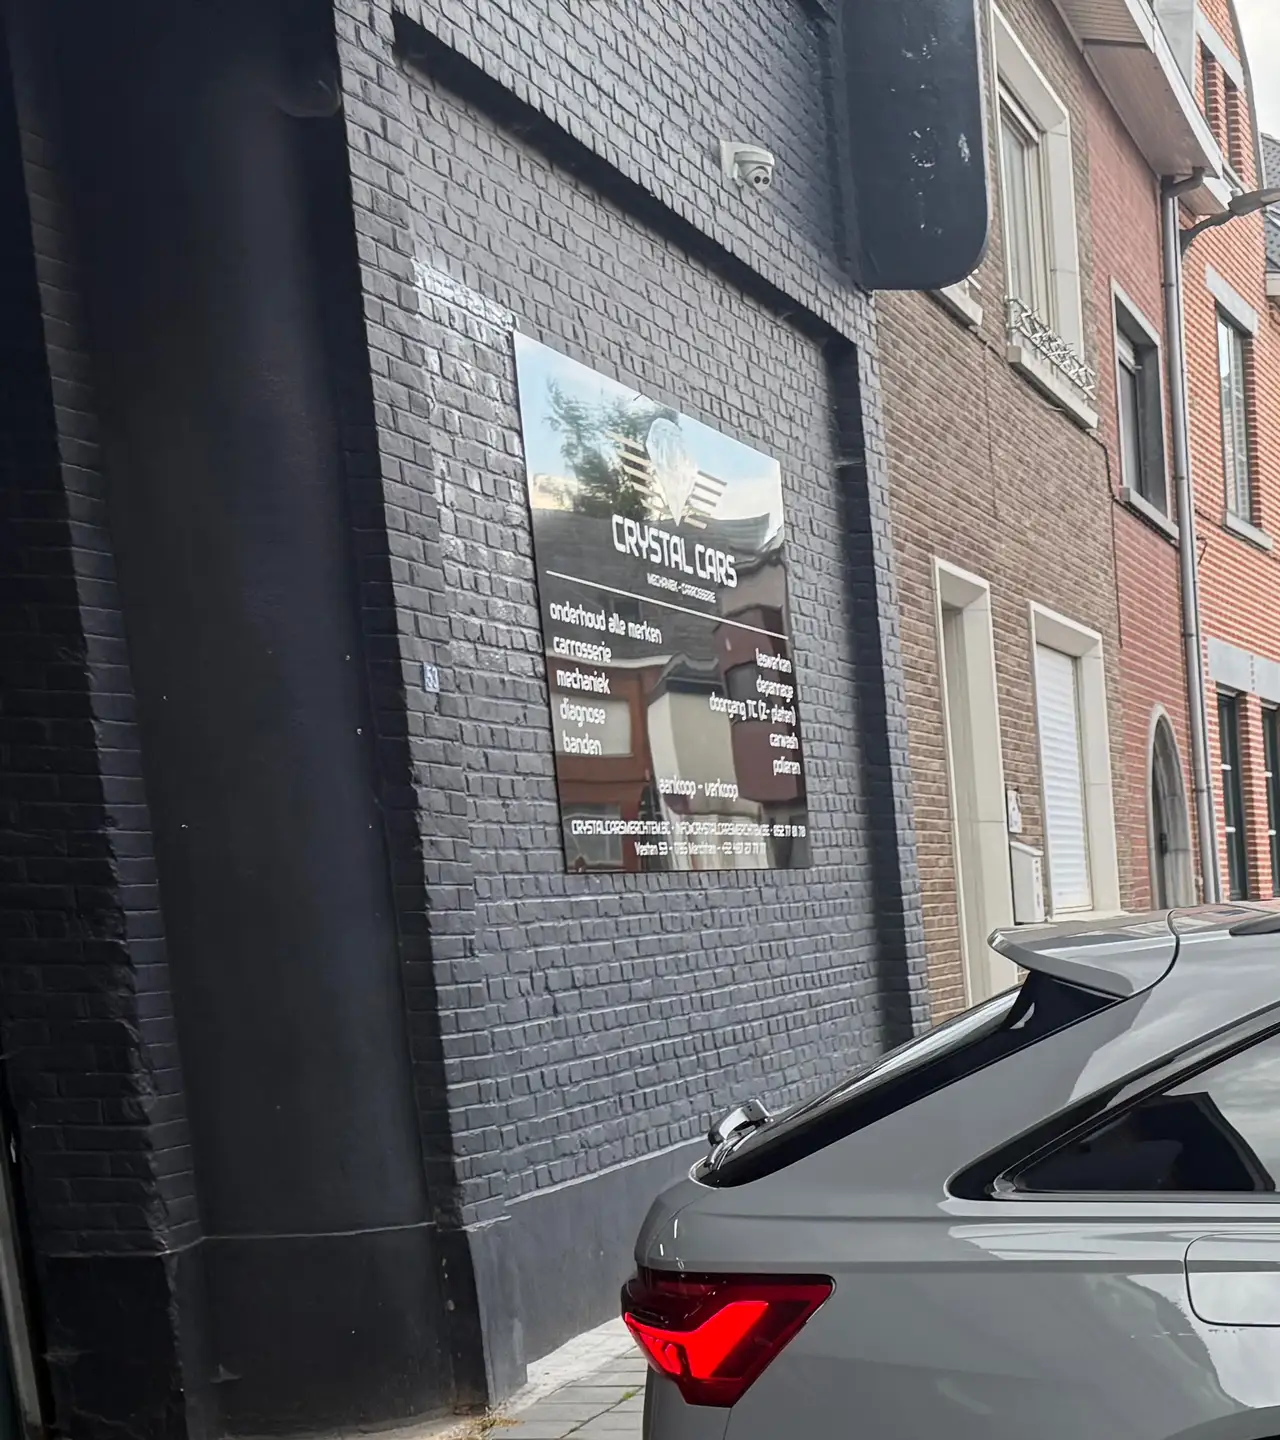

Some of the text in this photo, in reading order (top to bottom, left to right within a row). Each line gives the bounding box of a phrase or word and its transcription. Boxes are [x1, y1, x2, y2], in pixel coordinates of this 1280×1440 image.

[612, 513, 738, 588] CRYSTAL CARS
[550, 601, 662, 644] onderhoud alle merken
[553, 636, 612, 663] carrosserie
[556, 667, 611, 695] mechaniek
[560, 698, 606, 728] diagnose
[709, 691, 746, 721] doorgang
[562, 730, 603, 755] banden
[660, 775, 696, 799] aankoop
[705, 778, 739, 802] verkoop
